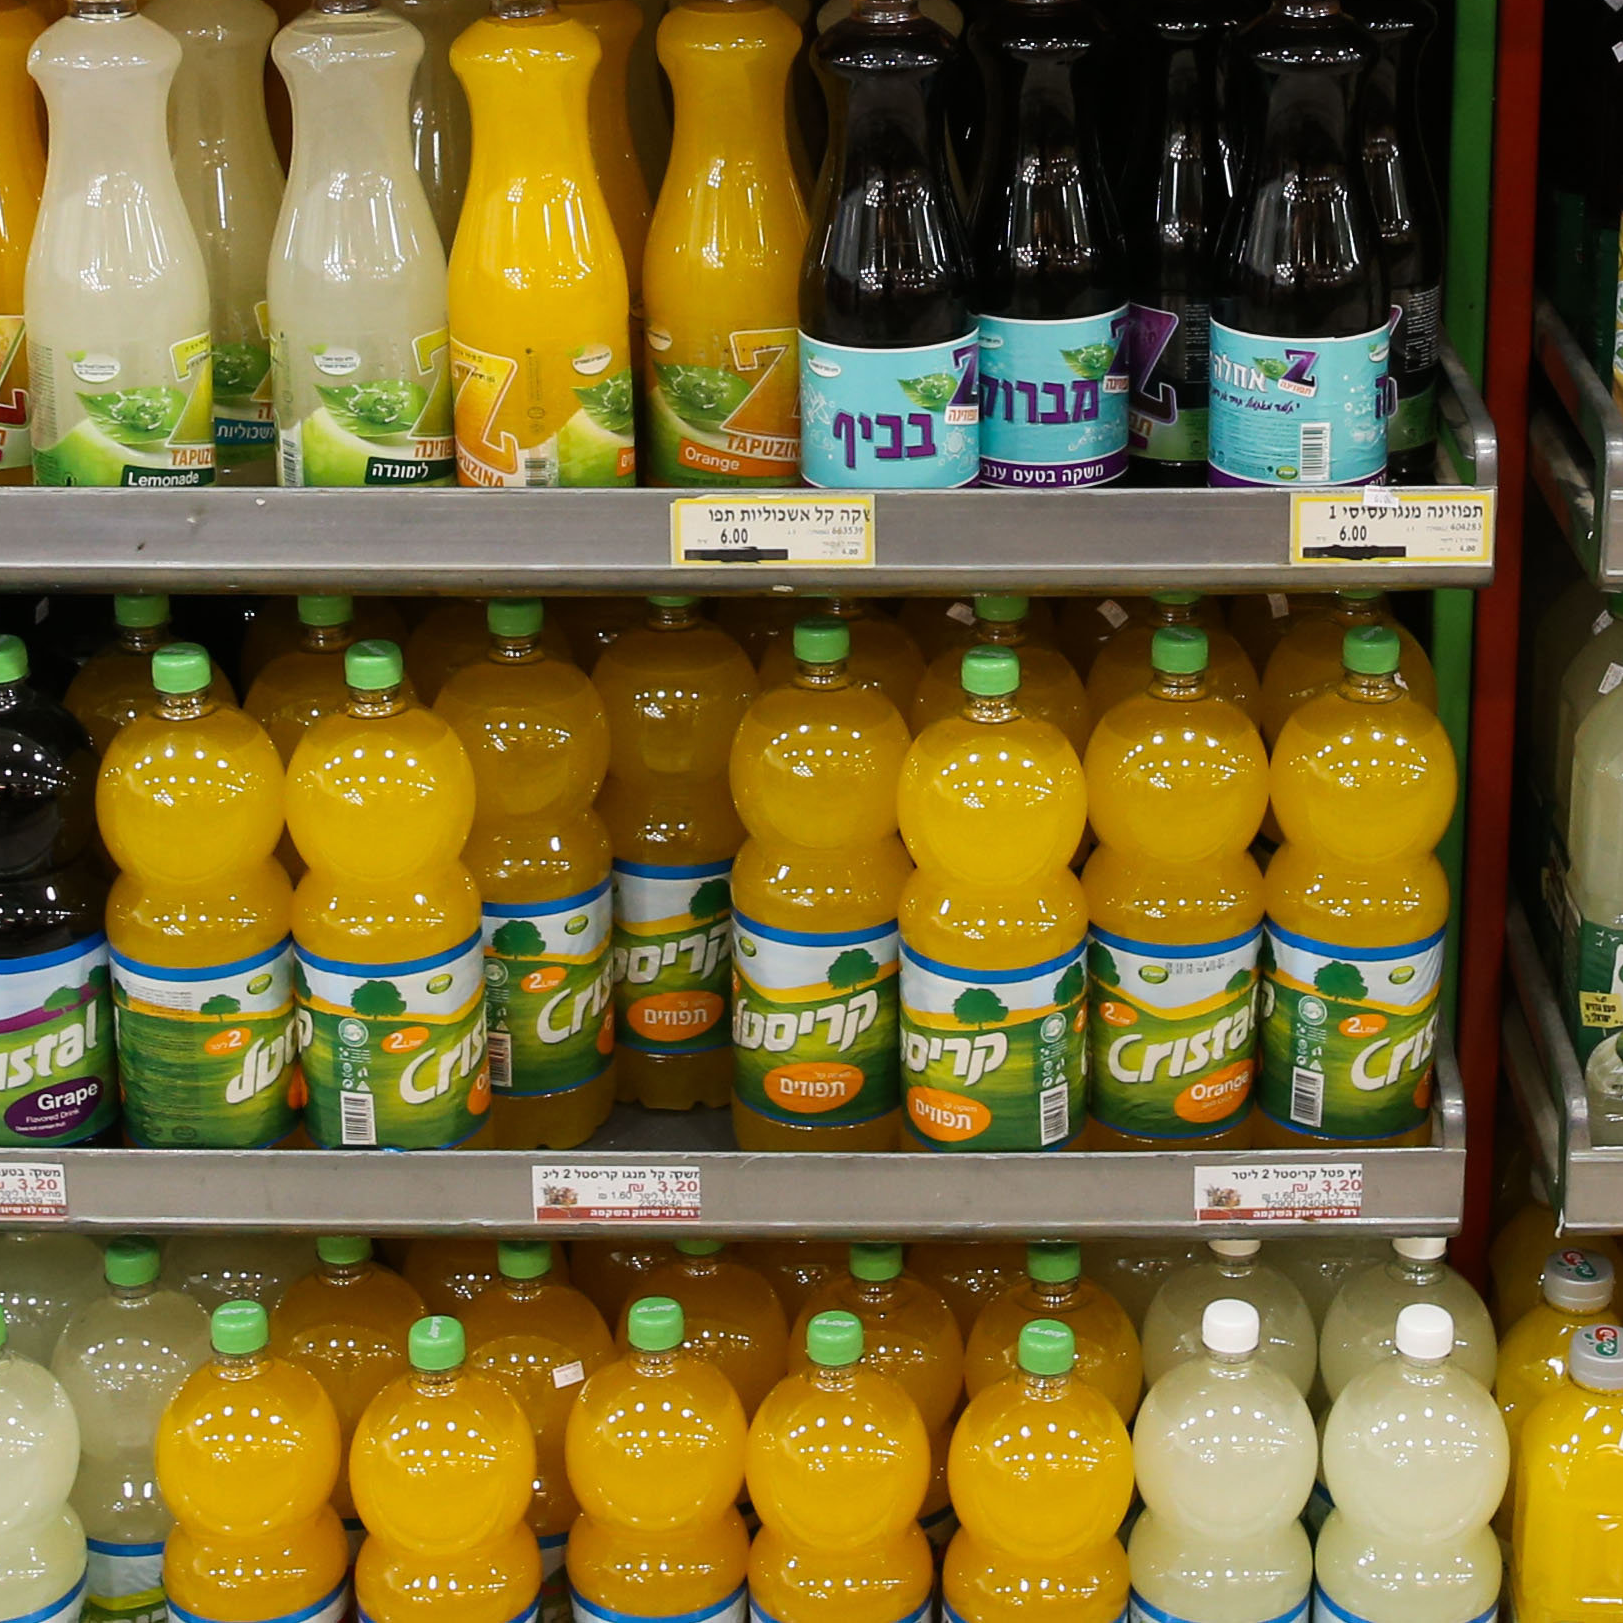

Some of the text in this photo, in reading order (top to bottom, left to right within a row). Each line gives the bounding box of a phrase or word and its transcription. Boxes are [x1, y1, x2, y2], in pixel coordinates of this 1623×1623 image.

[684, 447, 741, 472] Orange
[127, 471, 200, 488] Lemonade
[371, 462, 428, 480] לימונדה
[1013, 464, 1104, 485] משקה בטעם
[709, 508, 810, 521] אשכוליות תפו
[1427, 505, 1483, 519] תפוזינה
[721, 529, 748, 544] 6.00
[1339, 526, 1367, 541] 6.00
[1108, 982, 1261, 1084] Cristal
[779, 1079, 846, 1097] תפוזים
[1191, 1070, 1251, 1102] Orange
[38, 1081, 98, 1112] Grape
[915, 1100, 972, 1132] תפוזים
[18, 1179, 58, 1190] 3.20
[658, 1181, 698, 1192] 3.20
[1322, 1180, 1361, 1191] 3.20
